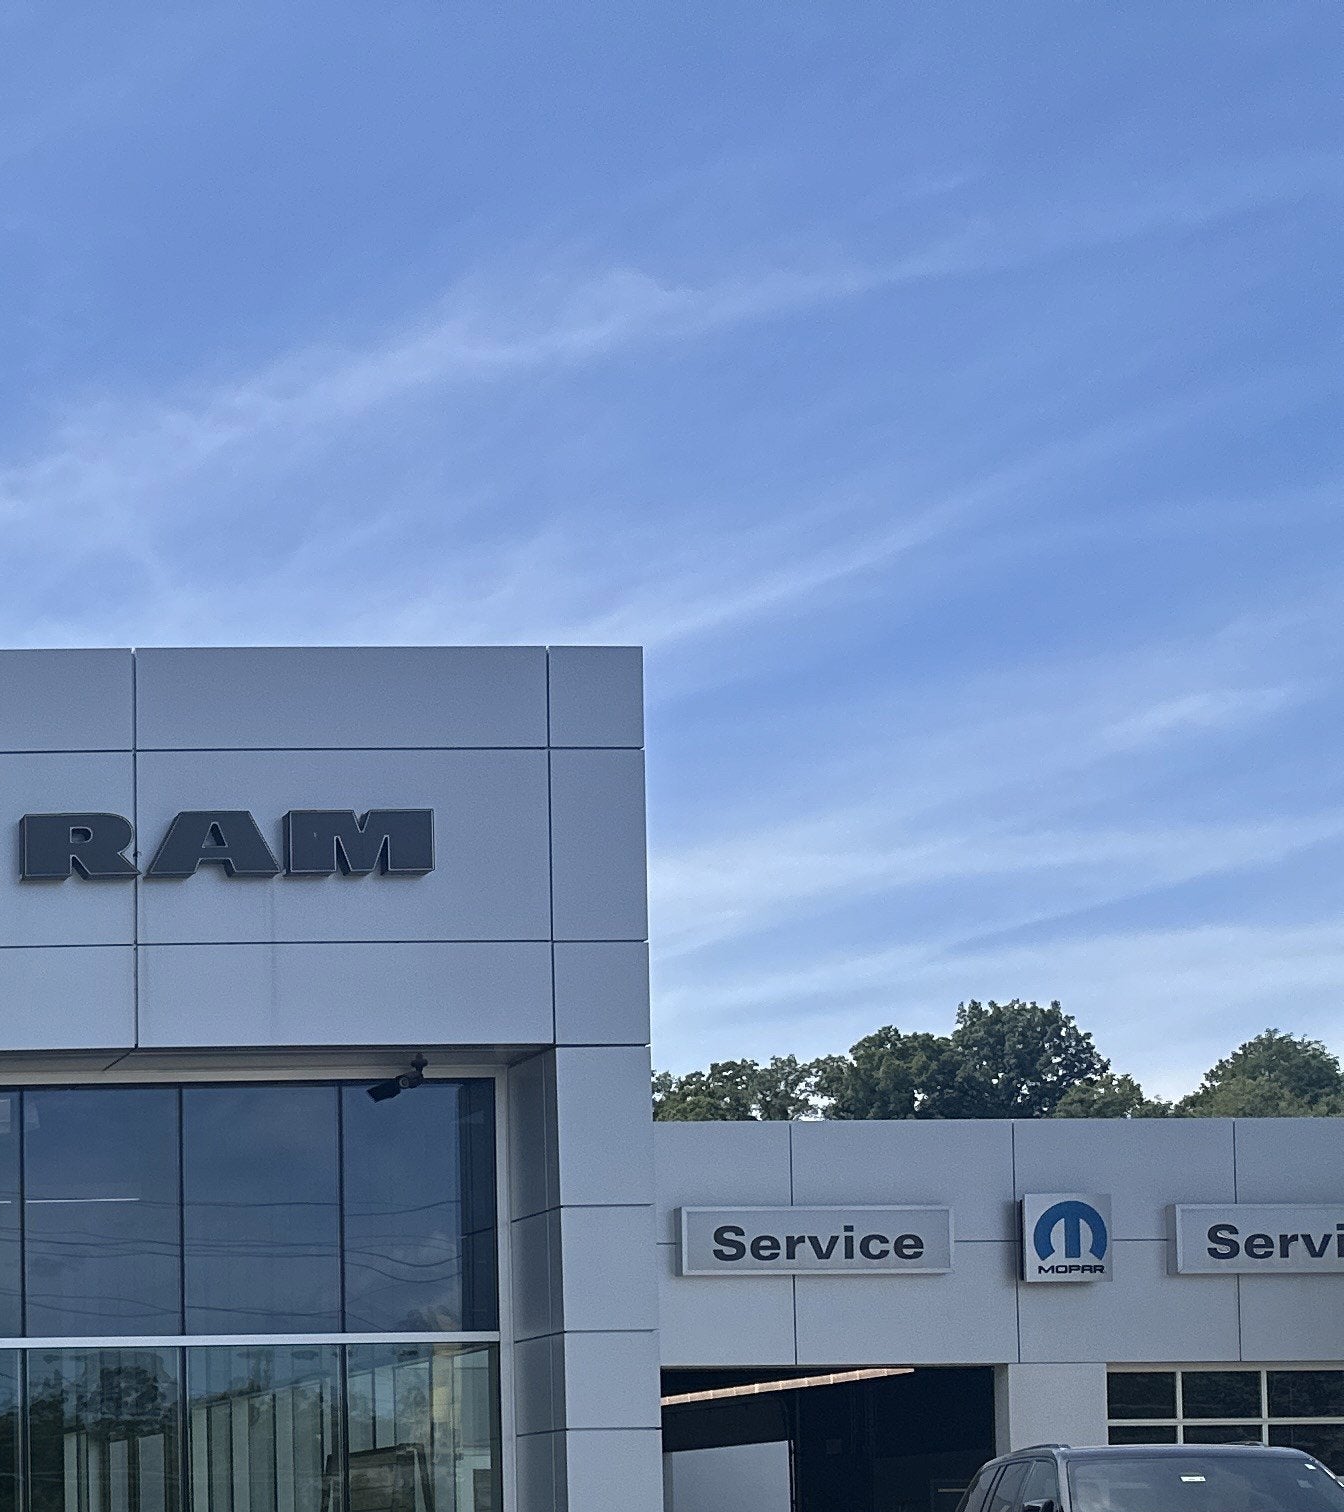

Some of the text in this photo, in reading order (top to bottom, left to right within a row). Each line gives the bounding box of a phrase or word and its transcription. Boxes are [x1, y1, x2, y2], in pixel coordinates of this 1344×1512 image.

[19, 808, 436, 881] RAM
[712, 1224, 925, 1262] Service
[1038, 1264, 1105, 1275] MOPAR
